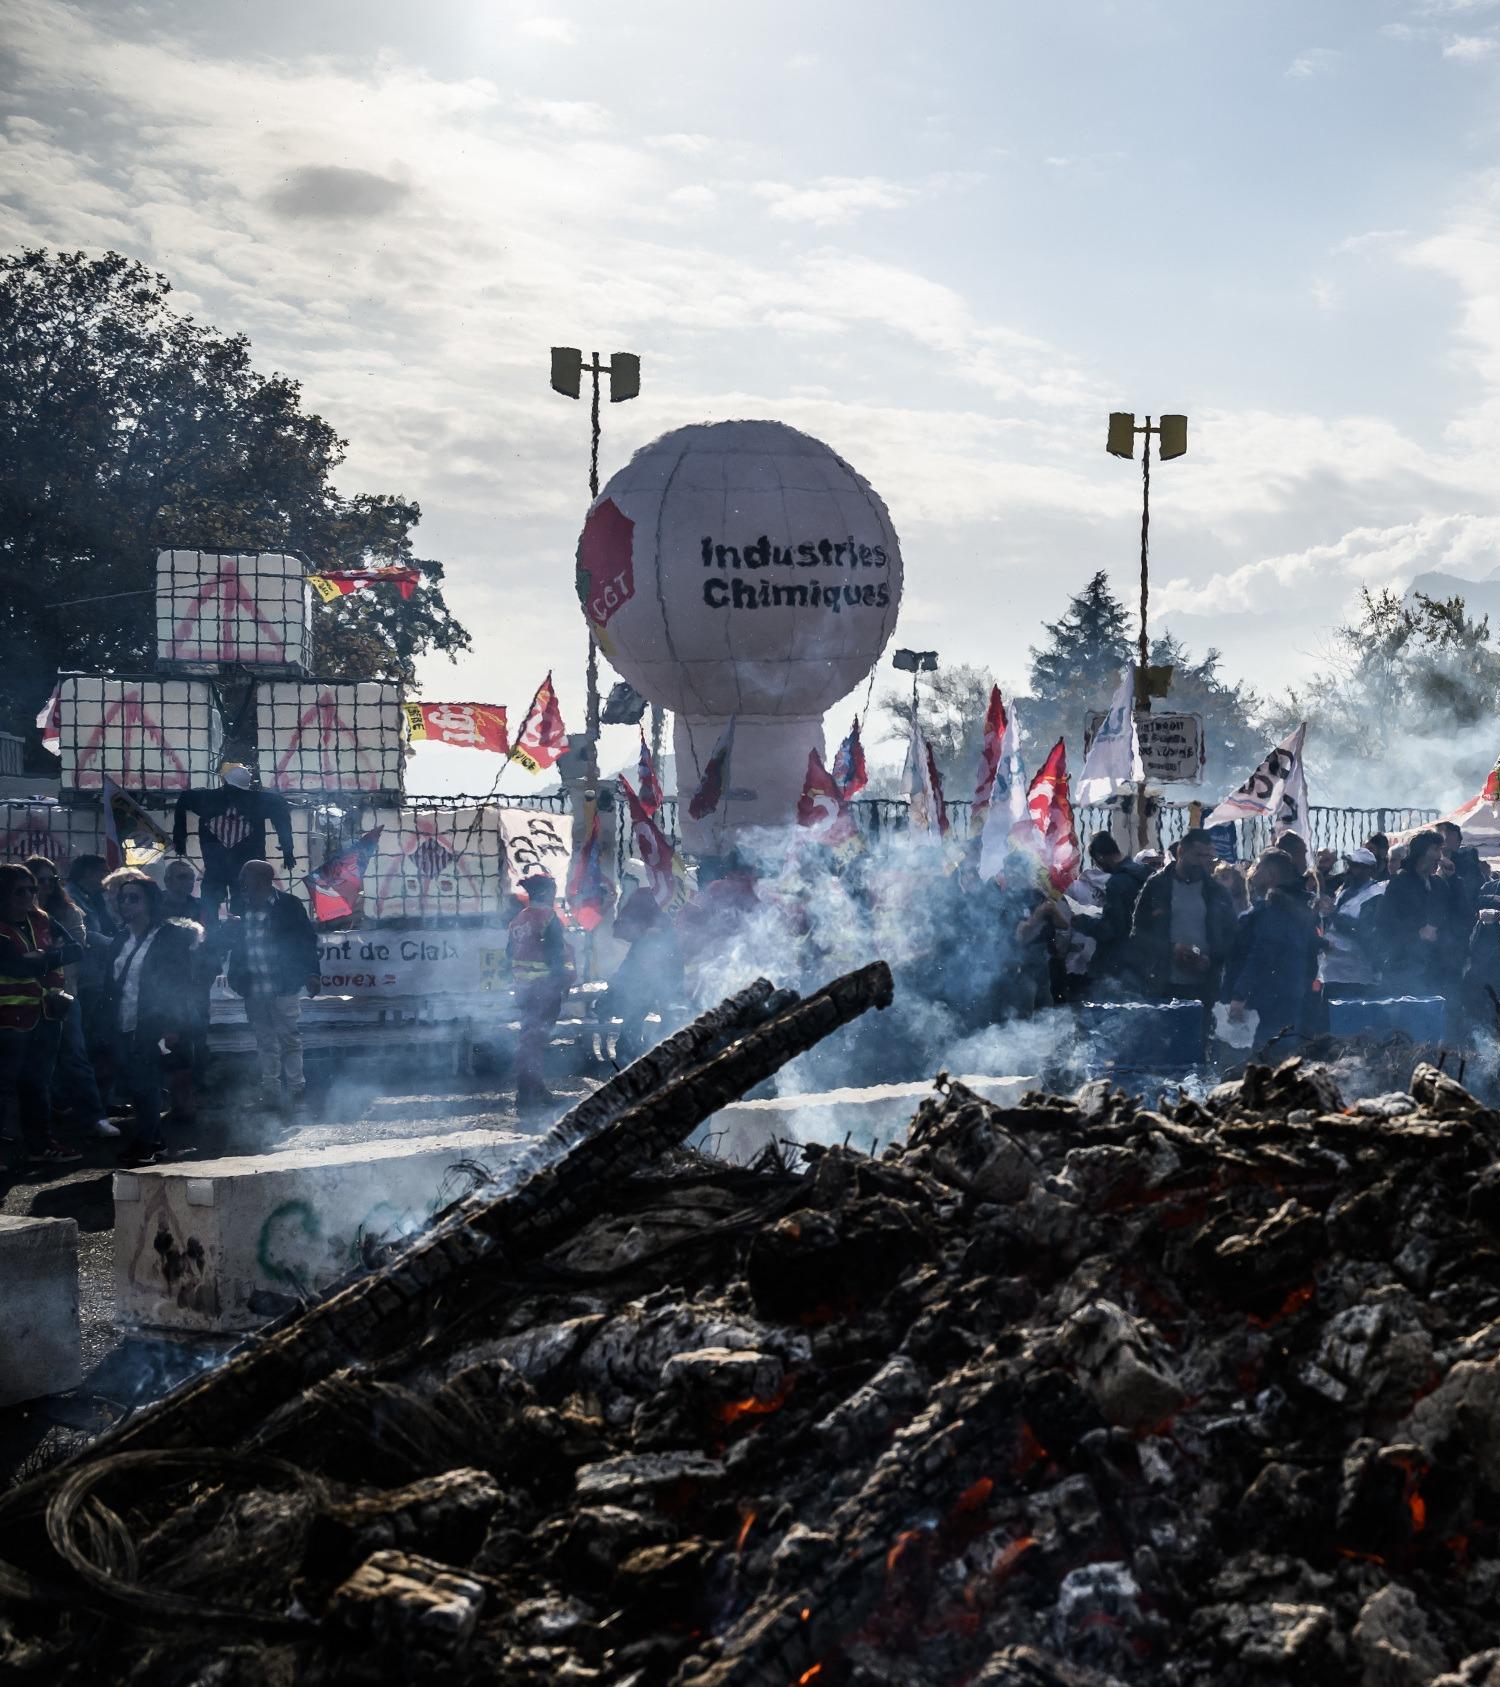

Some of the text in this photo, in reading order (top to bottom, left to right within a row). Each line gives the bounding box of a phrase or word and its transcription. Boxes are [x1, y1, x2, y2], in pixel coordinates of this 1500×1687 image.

[701, 535, 887, 569] Industries
[593, 570, 629, 620] CGT
[703, 578, 891, 613] Chimiques
[359, 942, 390, 961] de
